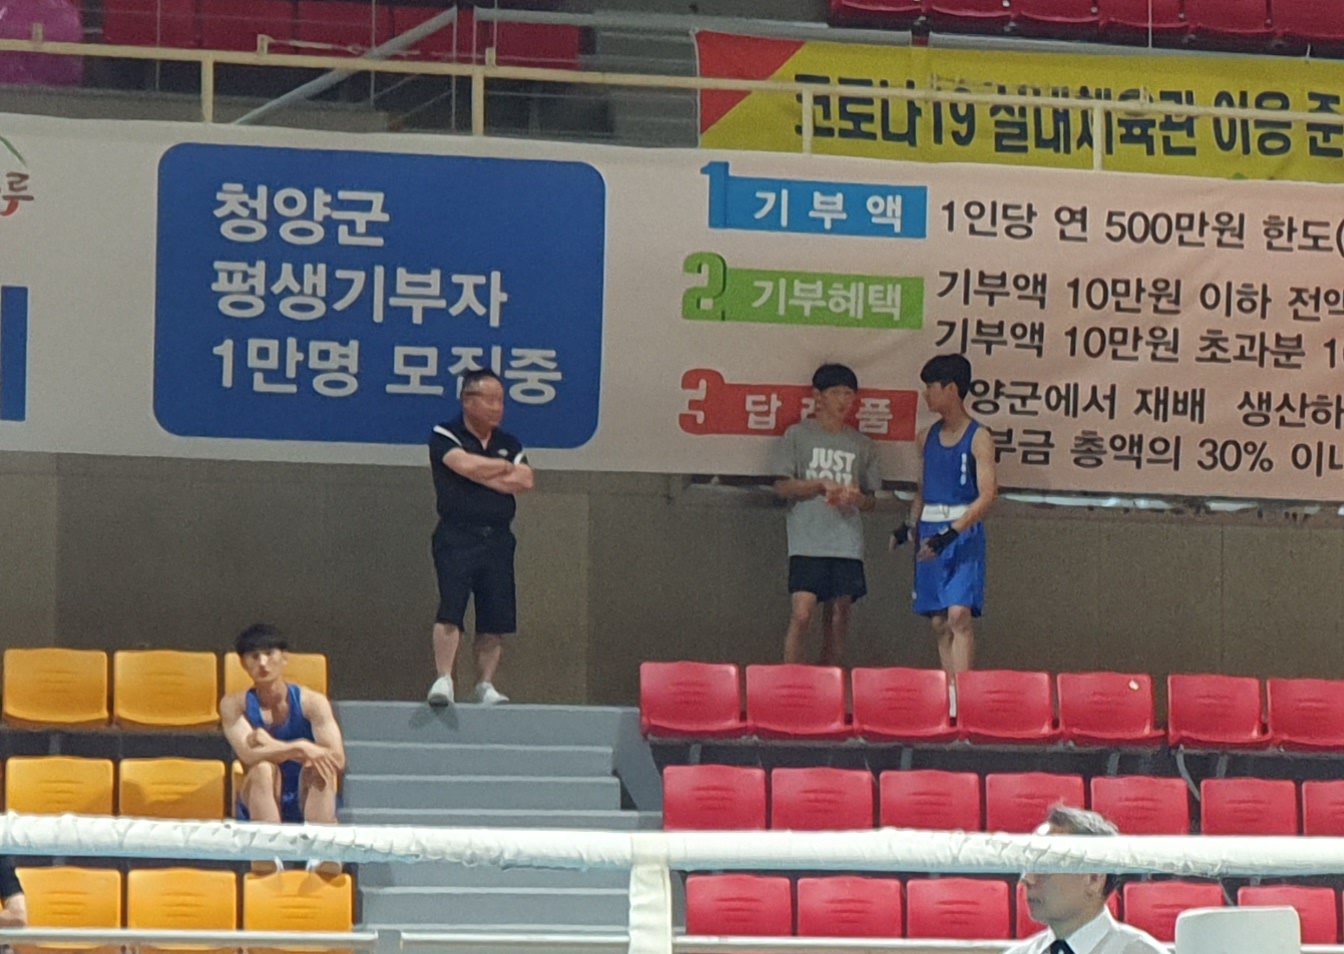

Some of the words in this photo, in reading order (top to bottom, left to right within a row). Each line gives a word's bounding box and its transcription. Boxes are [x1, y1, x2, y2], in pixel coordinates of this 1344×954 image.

[213, 182, 390, 246] 청양군
[941, 200, 1038, 240] 1인당
[1054, 205, 1088, 243] 연
[1105, 210, 1246, 249] 500만원
[211, 260, 508, 328] 평생기부자
[752, 277, 902, 321] 기부혜택
[937, 268, 1048, 310] 기부액
[1066, 276, 1182, 315] 10만원
[1200, 281, 1272, 320] 이하
[213, 337, 360, 397] 1만명
[935, 317, 1045, 358] 기부액
[1064, 325, 1180, 364] 10만원
[1195, 328, 1306, 371] 초과분
[969, 379, 1117, 420] 양군에서
[1133, 385, 1206, 425] 재배
[809, 448, 856, 473] JUST
[986, 426, 1055, 465] 부금
[1070, 430, 1181, 471] 총액의
[1197, 438, 1274, 472] 30%
